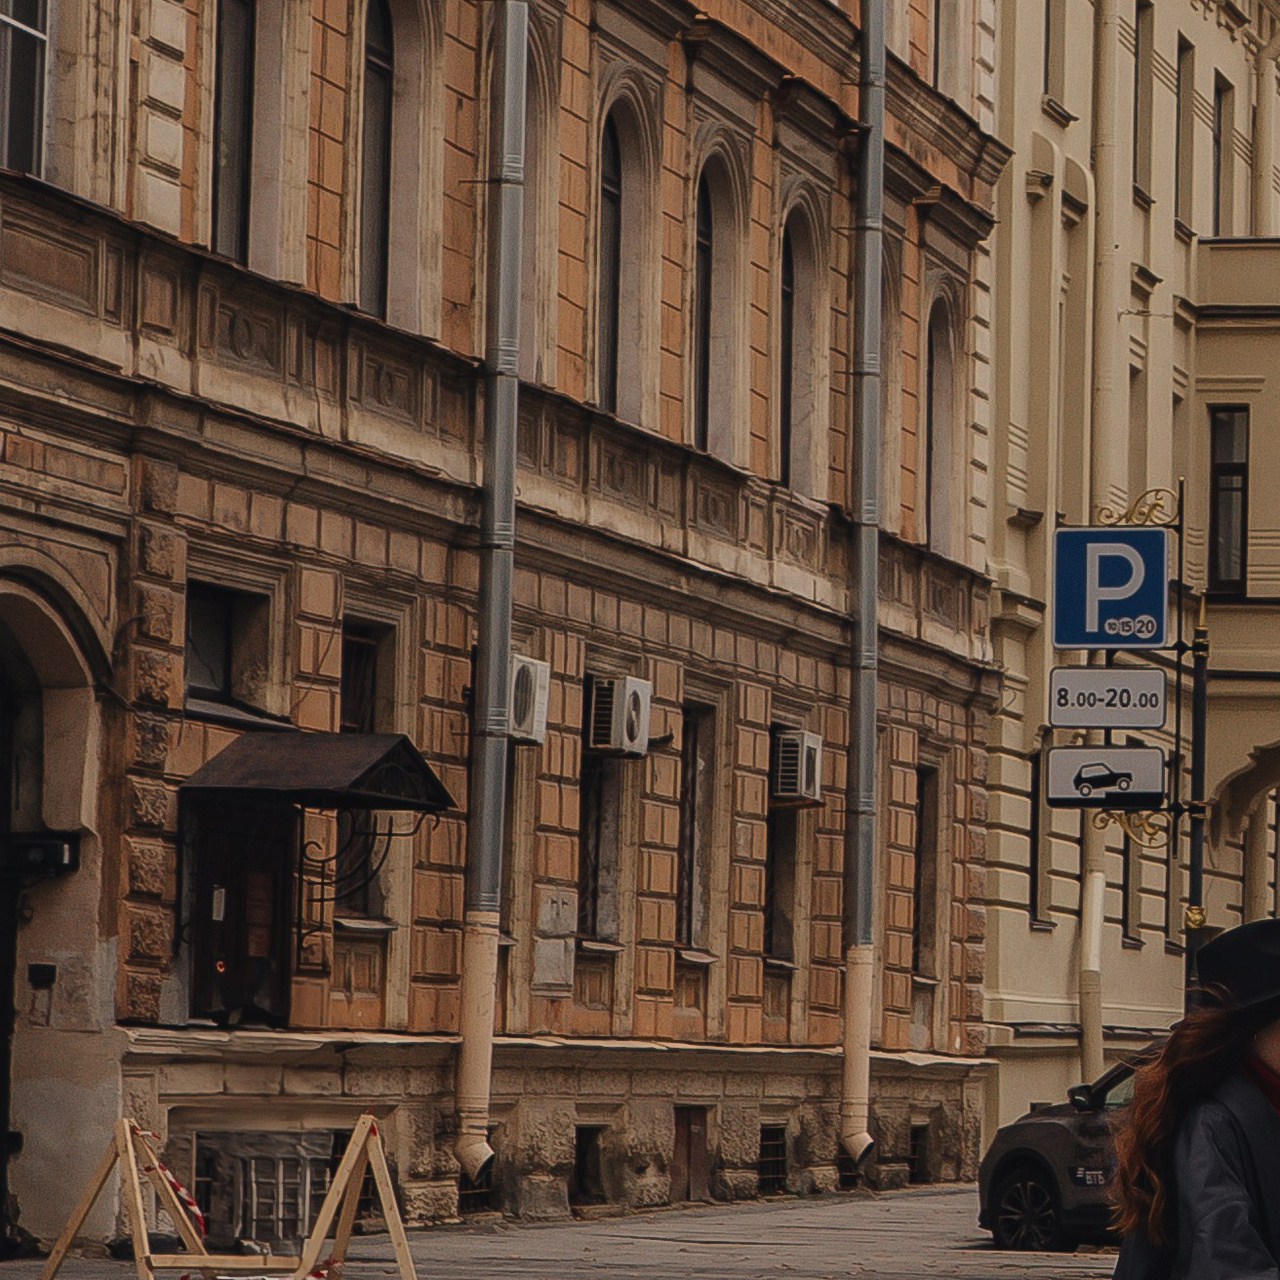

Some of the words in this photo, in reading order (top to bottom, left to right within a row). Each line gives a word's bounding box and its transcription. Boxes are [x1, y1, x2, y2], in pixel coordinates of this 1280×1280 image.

[1086, 543, 1145, 632] P
[1120, 621, 1132, 632] 15
[1136, 620, 1155, 634] 20
[1057, 687, 1159, 708] 8.00-20.00
